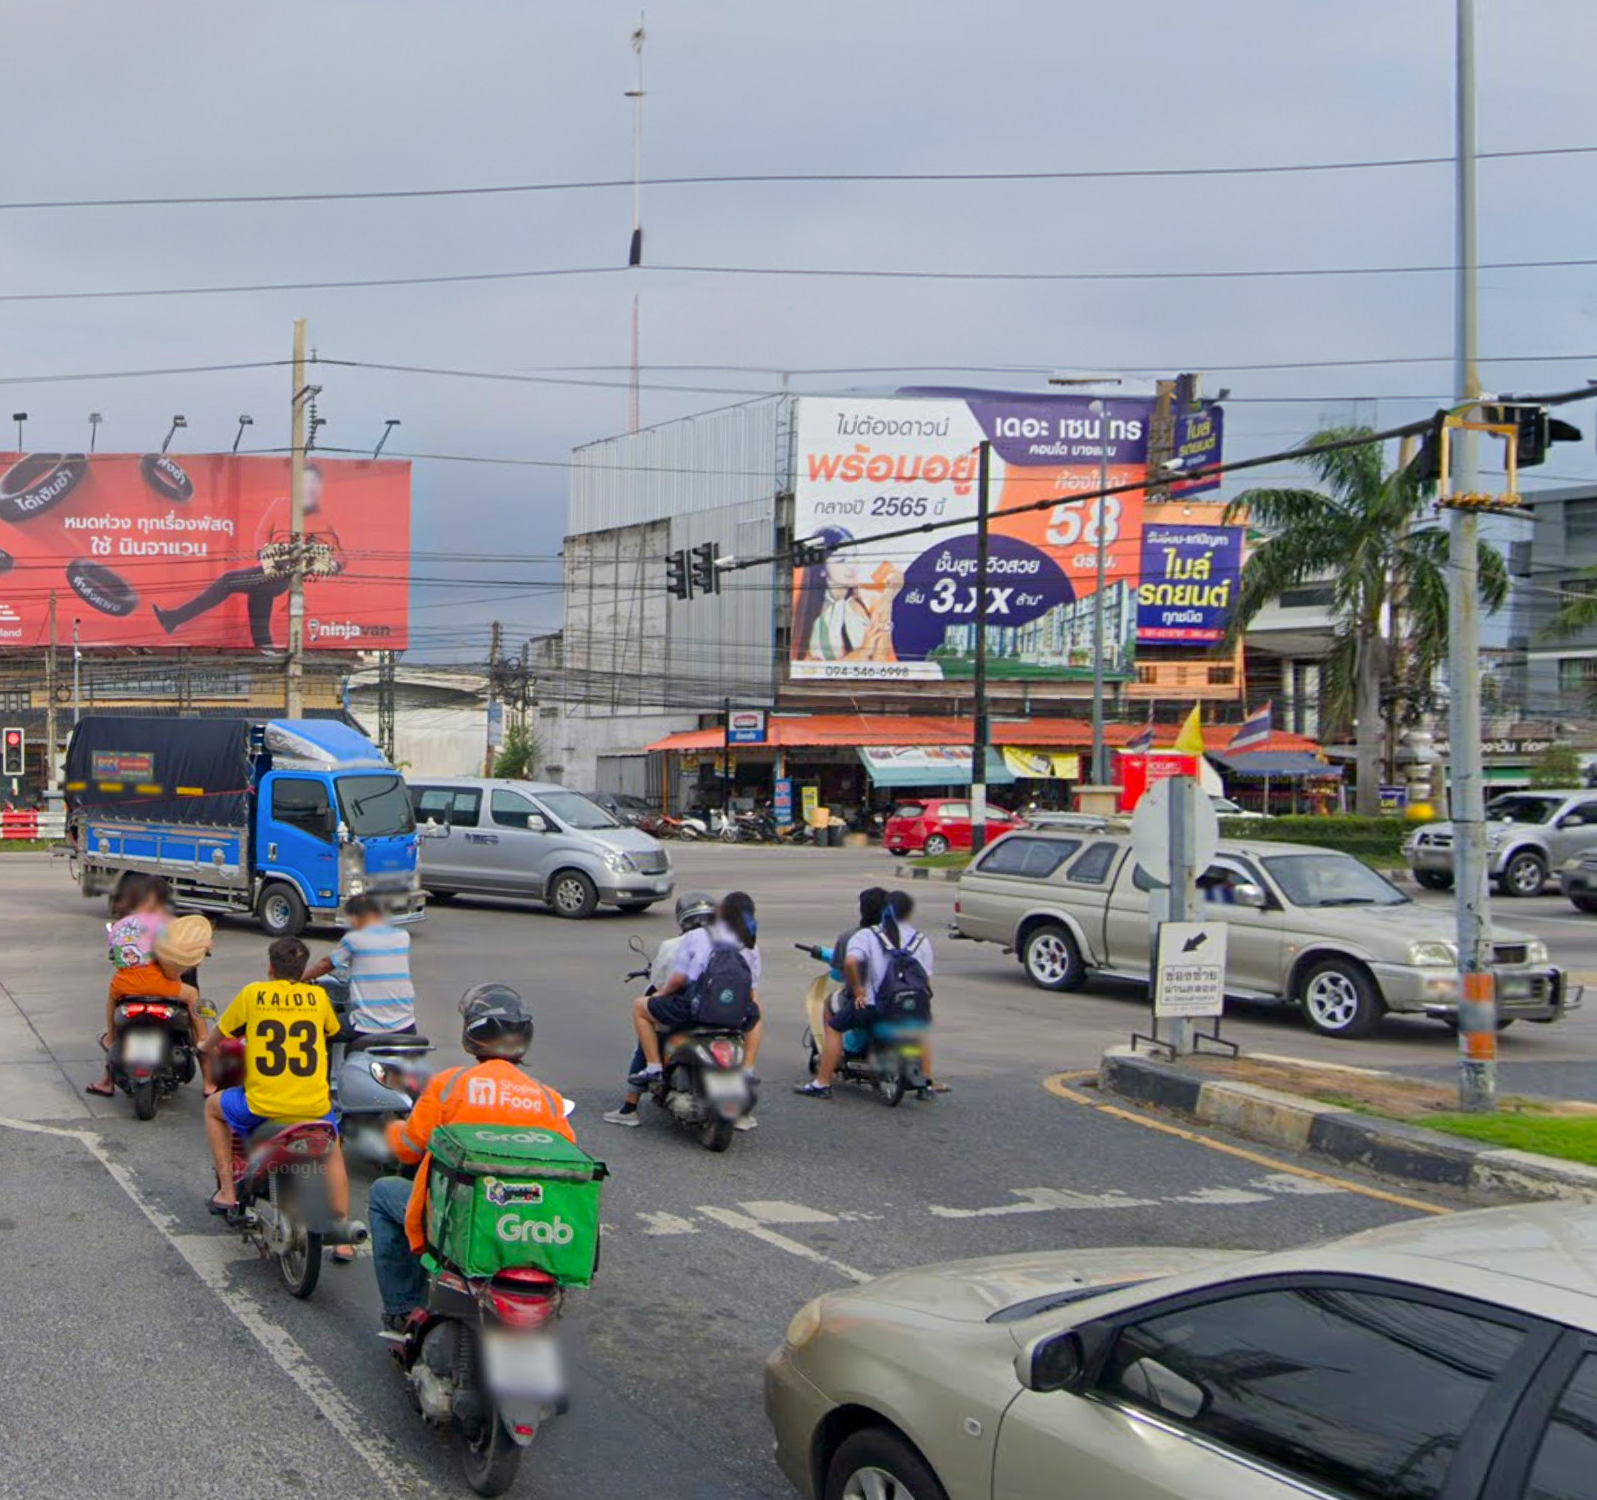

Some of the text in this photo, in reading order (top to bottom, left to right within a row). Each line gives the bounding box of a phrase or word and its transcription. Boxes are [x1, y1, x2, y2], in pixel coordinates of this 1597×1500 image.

[837, 413, 951, 437] ไม่ต้องดาวน์
[995, 417, 1049, 438] เดอะ
[1029, 441, 1068, 456] คอนโด
[808, 443, 980, 495] พร้อมอยู่
[814, 497, 948, 516] กลางปี 2565 นี้
[64, 509, 235, 536] หมดห่วง ทุกเรื่องพัสดุ
[1046, 496, 1120, 547] 58
[90, 535, 209, 556] ใช้ นินจาแวน
[986, 556, 1041, 575] วิวสวย
[1163, 547, 1213, 580] ไมล์
[1137, 578, 1232, 607] รถยนต์
[1162, 609, 1204, 626] ทุกชนิด
[825, 666, 910, 677] 094-546-6998
[256, 991, 317, 1006] KAIDO
[255, 1018, 318, 1077] 33
[499, 1092, 542, 1113] Food
[475, 1131, 554, 1144] Grab
[496, 1213, 575, 1245] Grab
